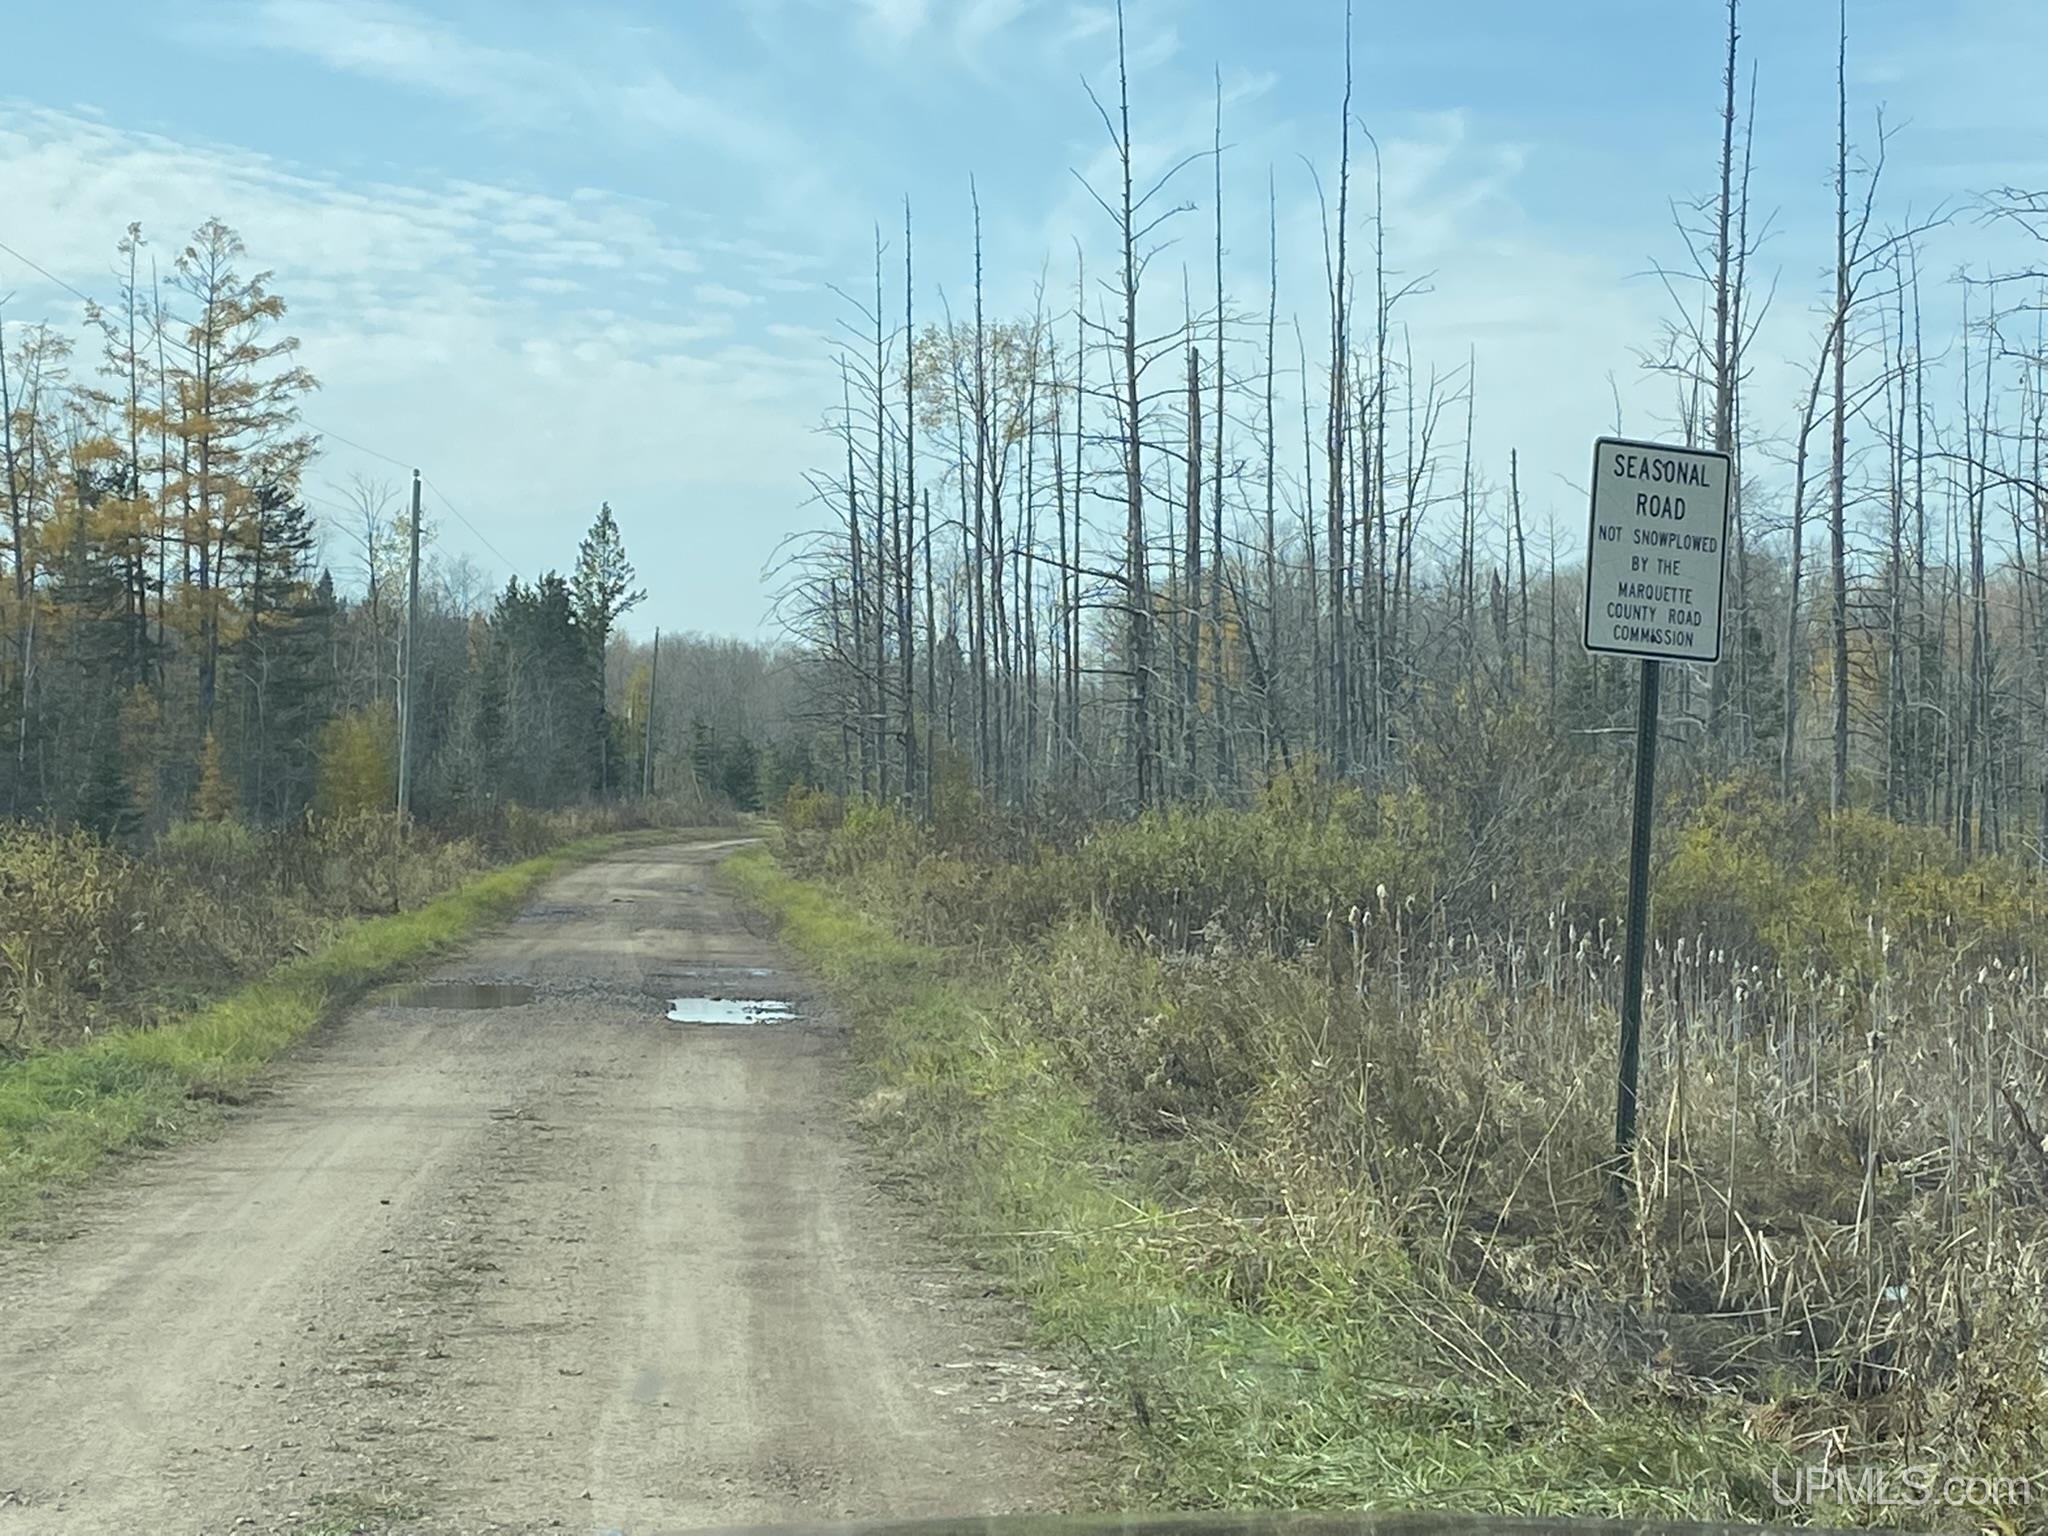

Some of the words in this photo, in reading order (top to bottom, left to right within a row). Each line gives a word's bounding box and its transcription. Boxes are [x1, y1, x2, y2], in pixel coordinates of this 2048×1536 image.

[1613, 454, 1711, 487] SEASONAL
[1636, 493, 1686, 520] ROAD
[1598, 525, 1623, 541] NOT
[1633, 529, 1717, 553] SNOWPLOWED
[1631, 556, 1649, 572] BY
[1657, 558, 1681, 576] THE
[1618, 582, 1693, 604] MARQUETTE
[1607, 602, 1656, 622] COUNTY
[1668, 608, 1702, 627] ROAD
